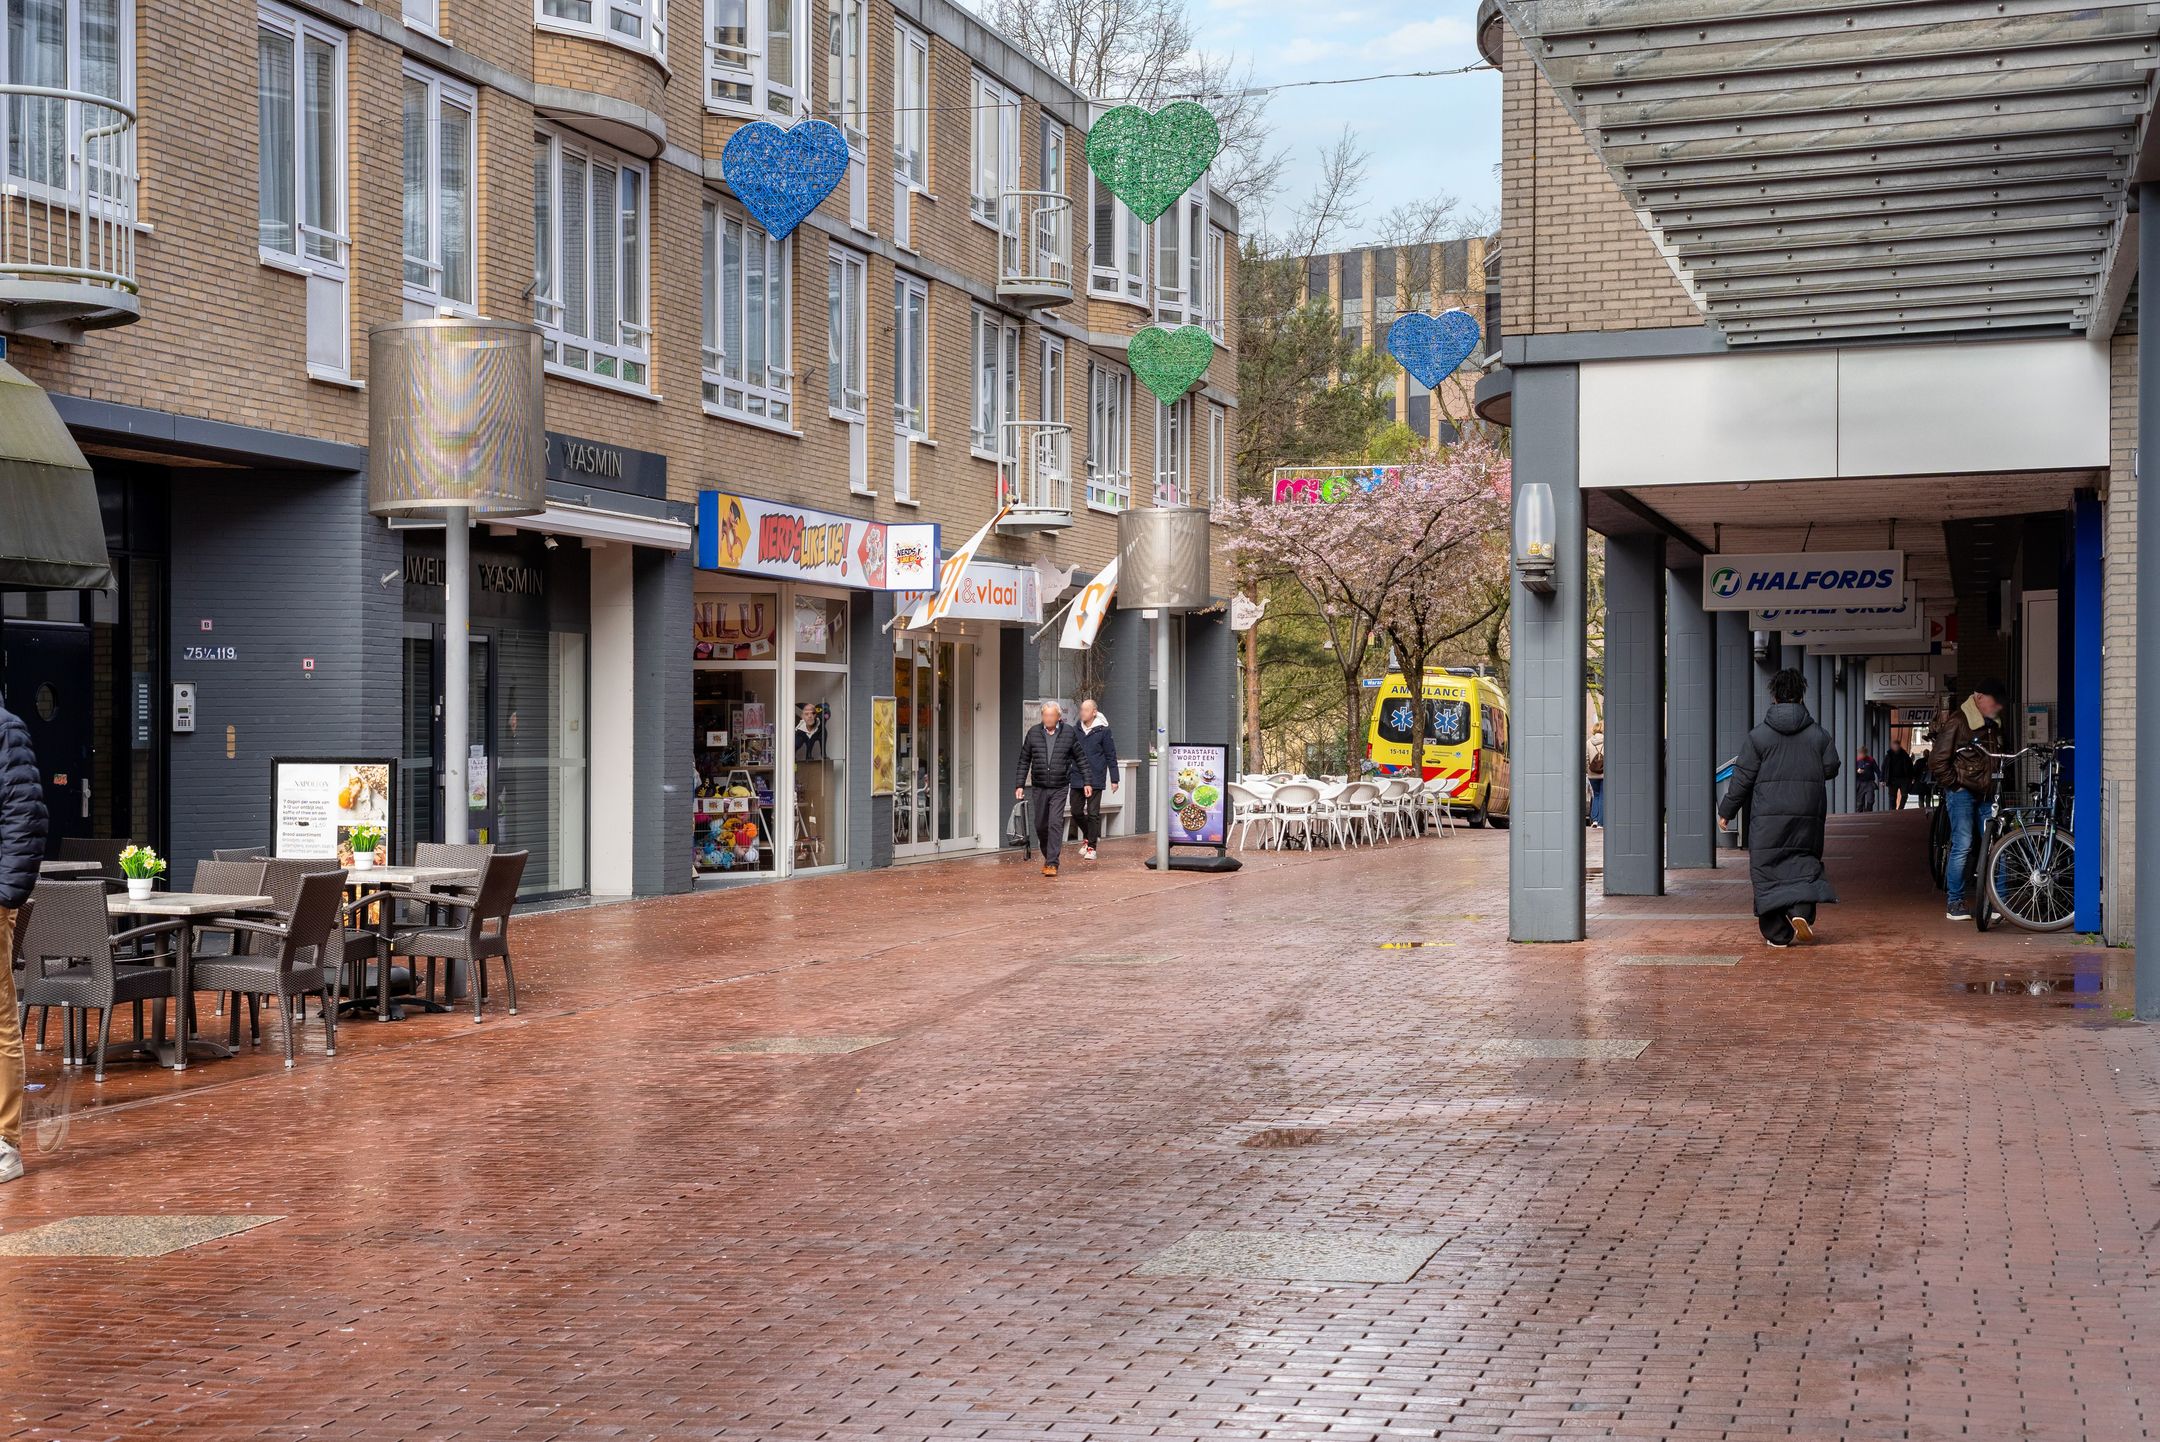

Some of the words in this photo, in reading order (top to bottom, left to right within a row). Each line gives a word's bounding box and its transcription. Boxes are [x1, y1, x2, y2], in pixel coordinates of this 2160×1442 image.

[567, 441, 622, 478] YASMIN
[758, 513, 804, 564] NERDS
[800, 523, 826, 571] LIKE
[827, 523, 851, 577] US!
[484, 563, 543, 596] YASMIN
[1746, 569, 1894, 591] HALFORDS
[217, 647, 235, 659] 119
[1391, 686, 1467, 697] AMULANCE
[1879, 674, 1924, 687] GENTS
